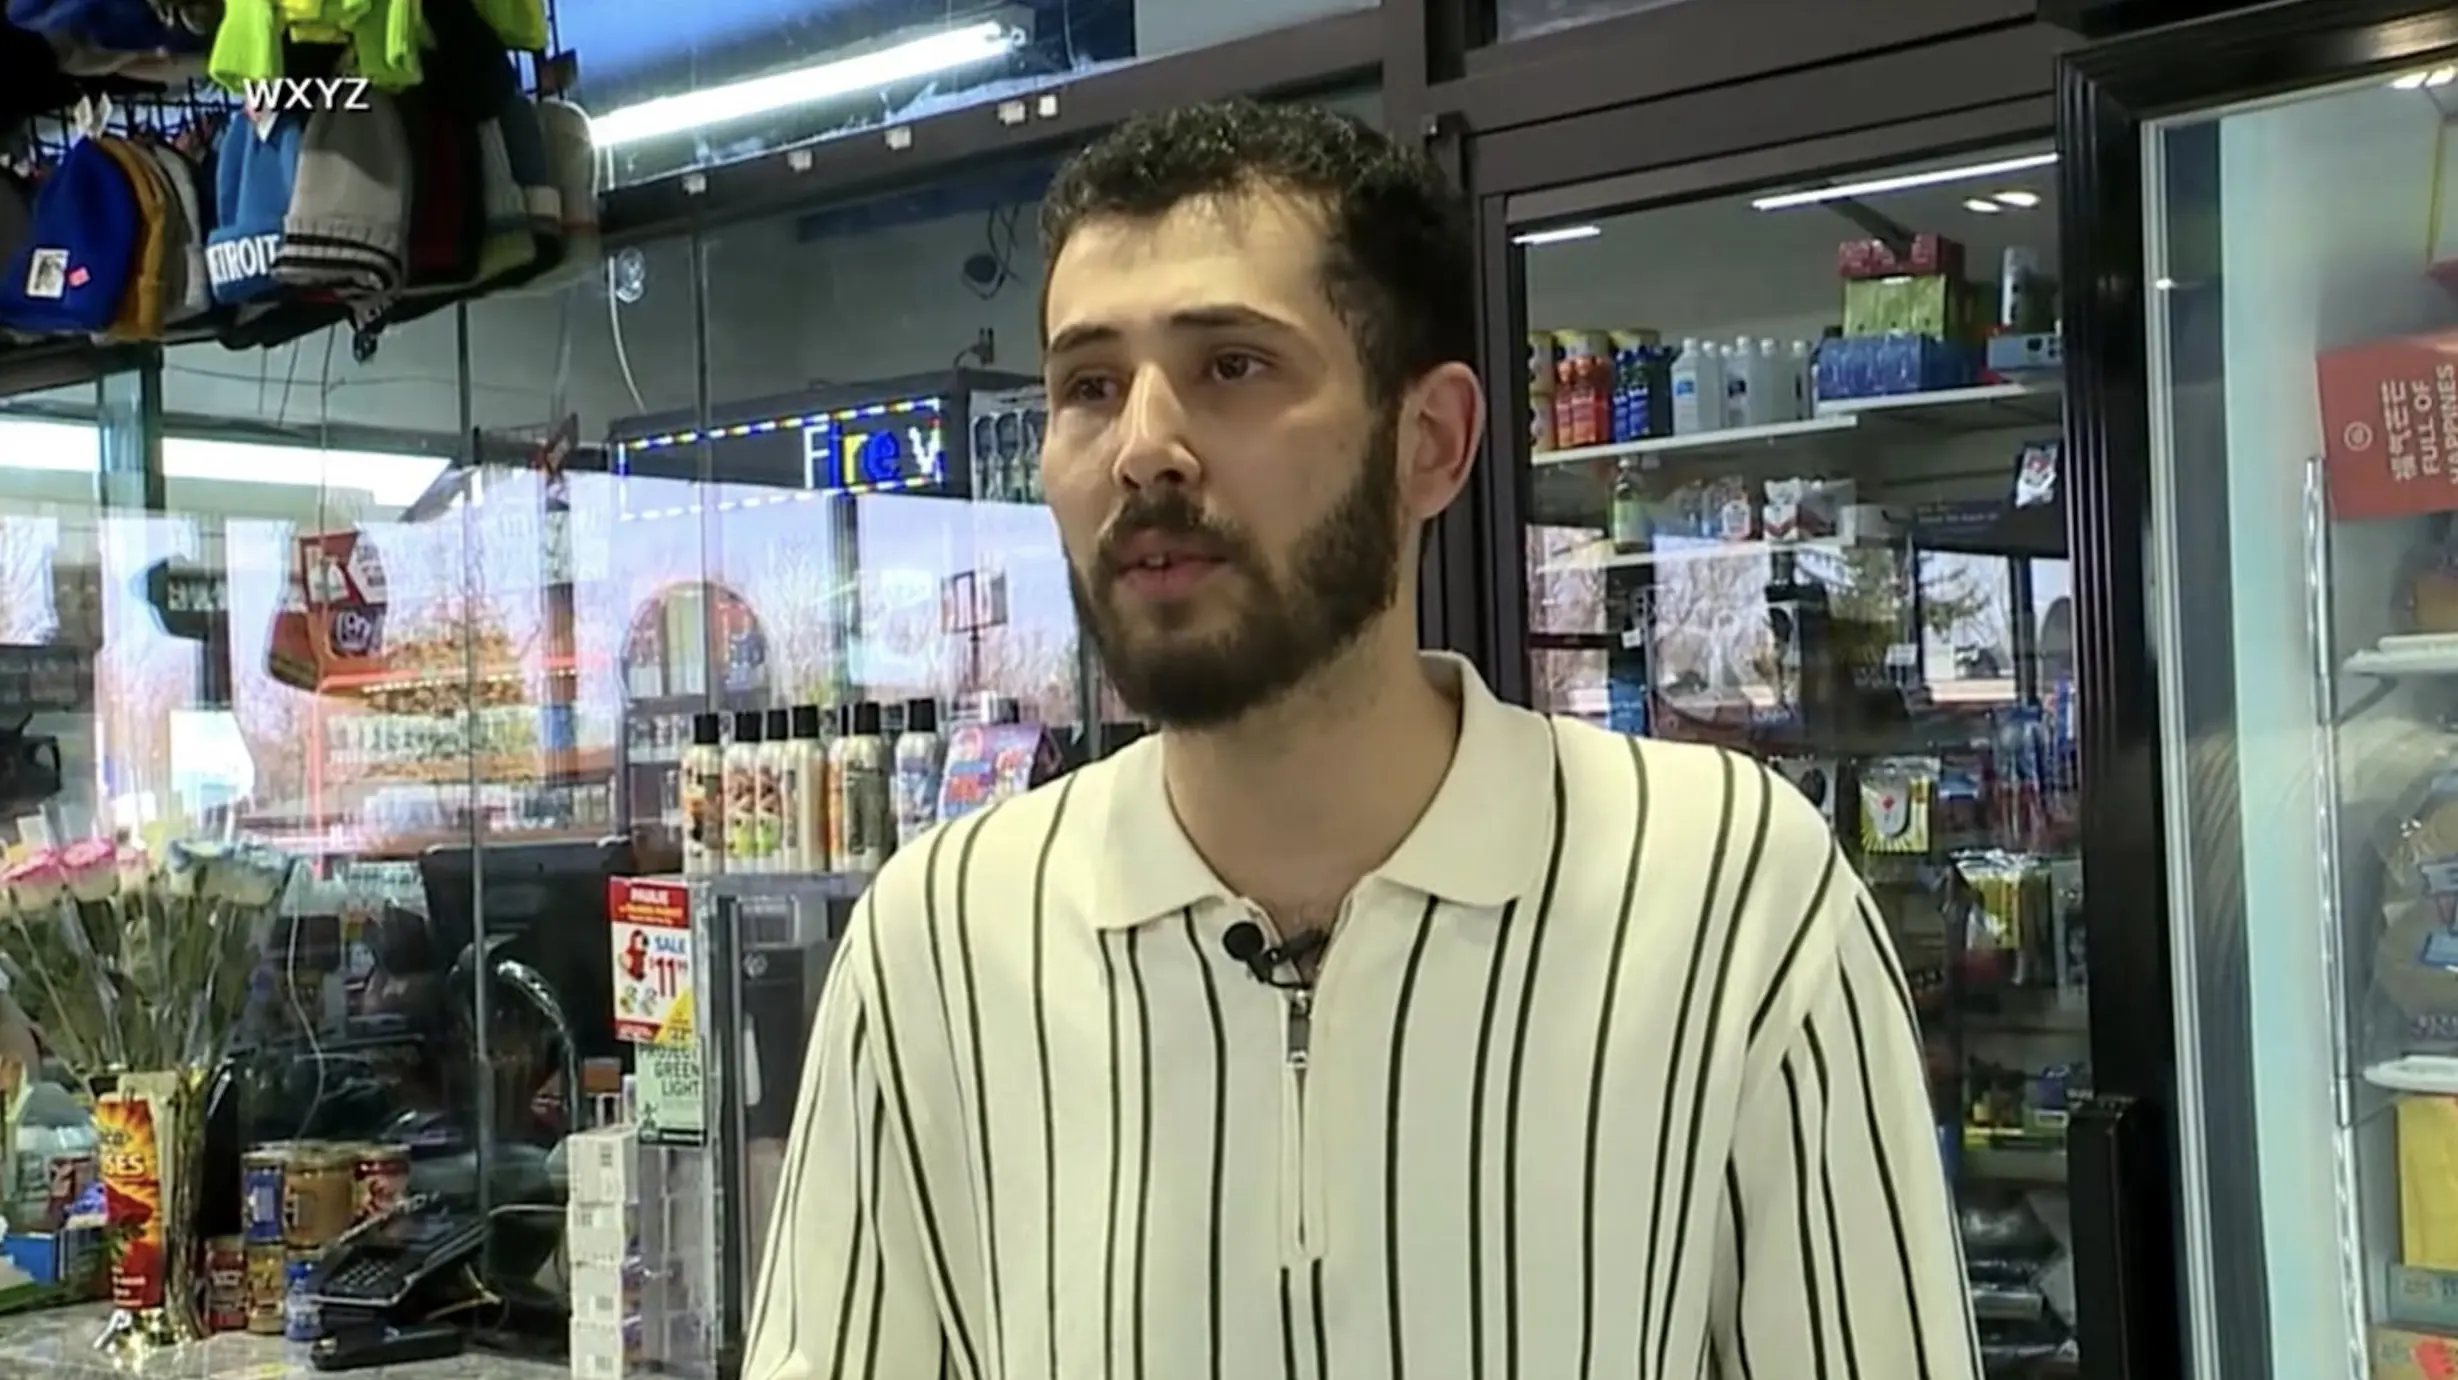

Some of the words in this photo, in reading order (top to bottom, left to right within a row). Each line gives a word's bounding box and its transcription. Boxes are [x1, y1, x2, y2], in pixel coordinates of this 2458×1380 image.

[2411, 380, 2433, 413] OF
[2417, 415, 2441, 476] FULL
[654, 935, 687, 955] SALE
[654, 1061, 700, 1079] GREEN
[661, 1079, 699, 1097] LIGHT
